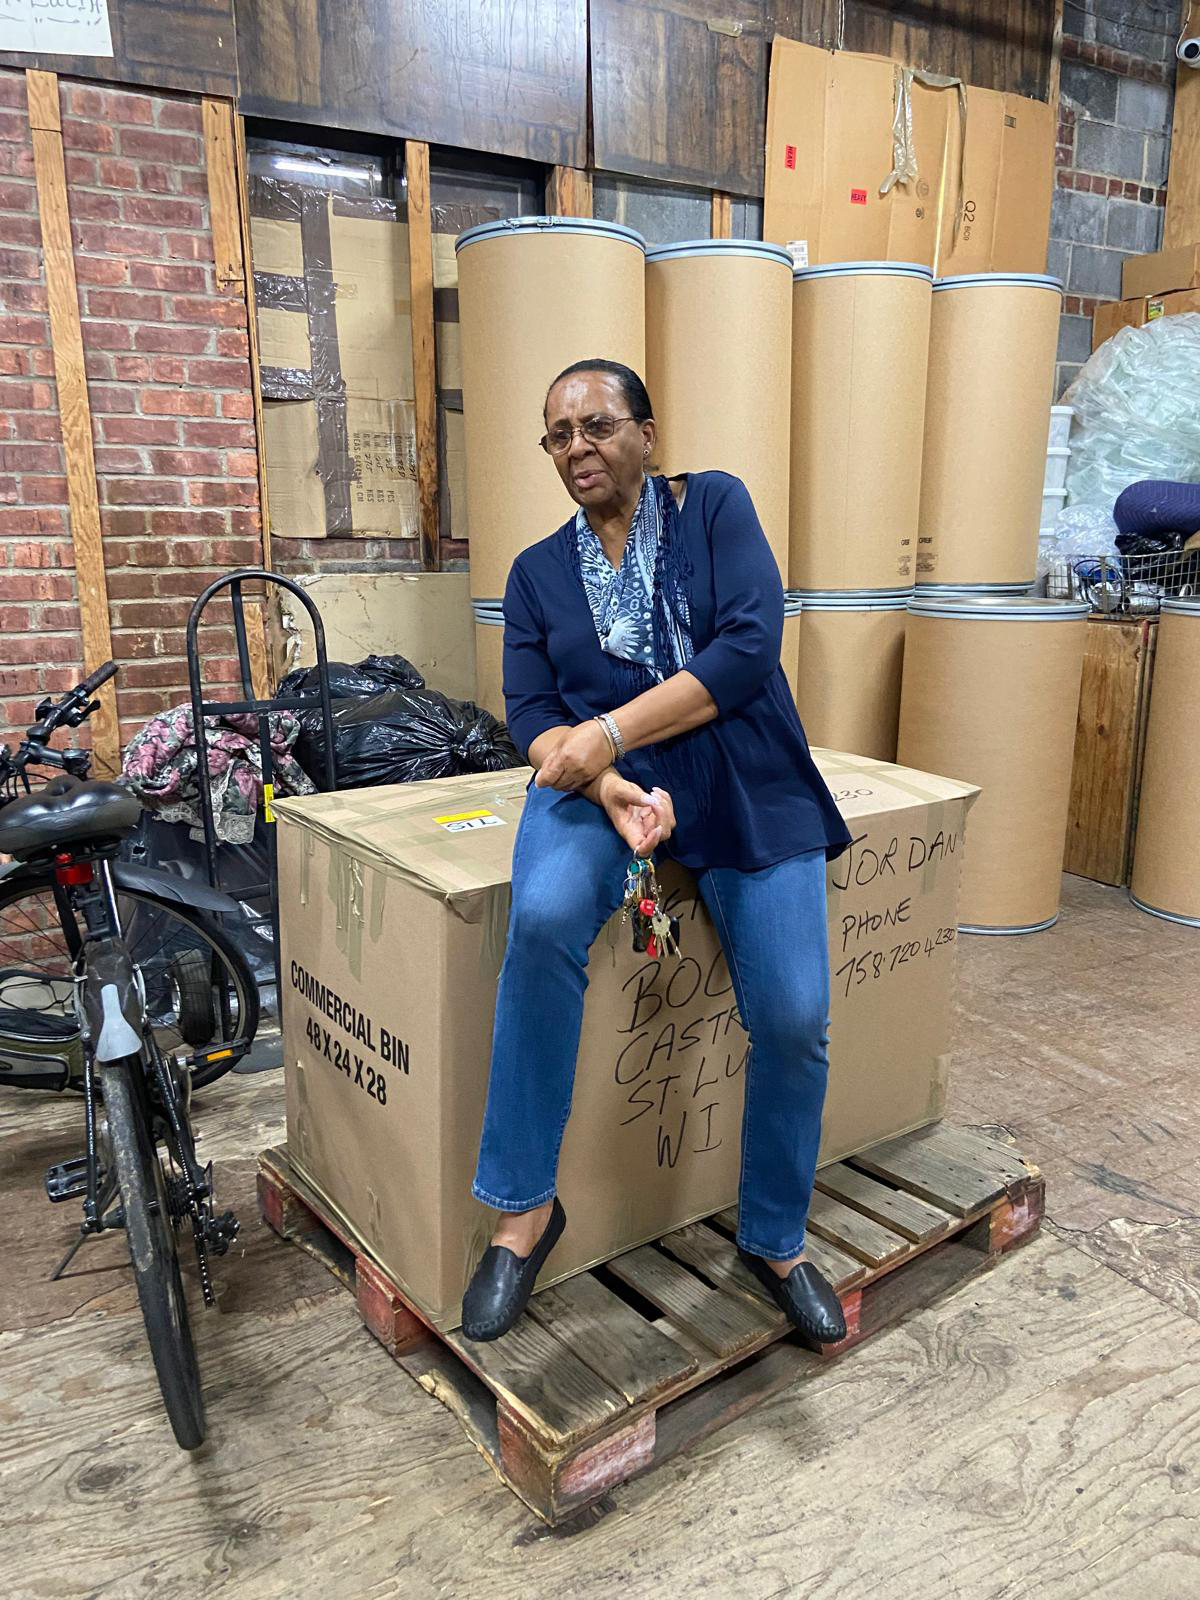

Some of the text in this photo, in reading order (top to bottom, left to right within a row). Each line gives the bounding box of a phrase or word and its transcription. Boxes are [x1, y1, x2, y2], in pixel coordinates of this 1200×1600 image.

[832, 788, 873, 801] 230
[842, 897, 911, 952] PHONE
[291, 960, 410, 1075] COMMERCIAL BIN
[616, 950, 734, 1033] BOC
[615, 1006, 743, 1085] CASTR
[619, 1046, 749, 1126] ST. LU
